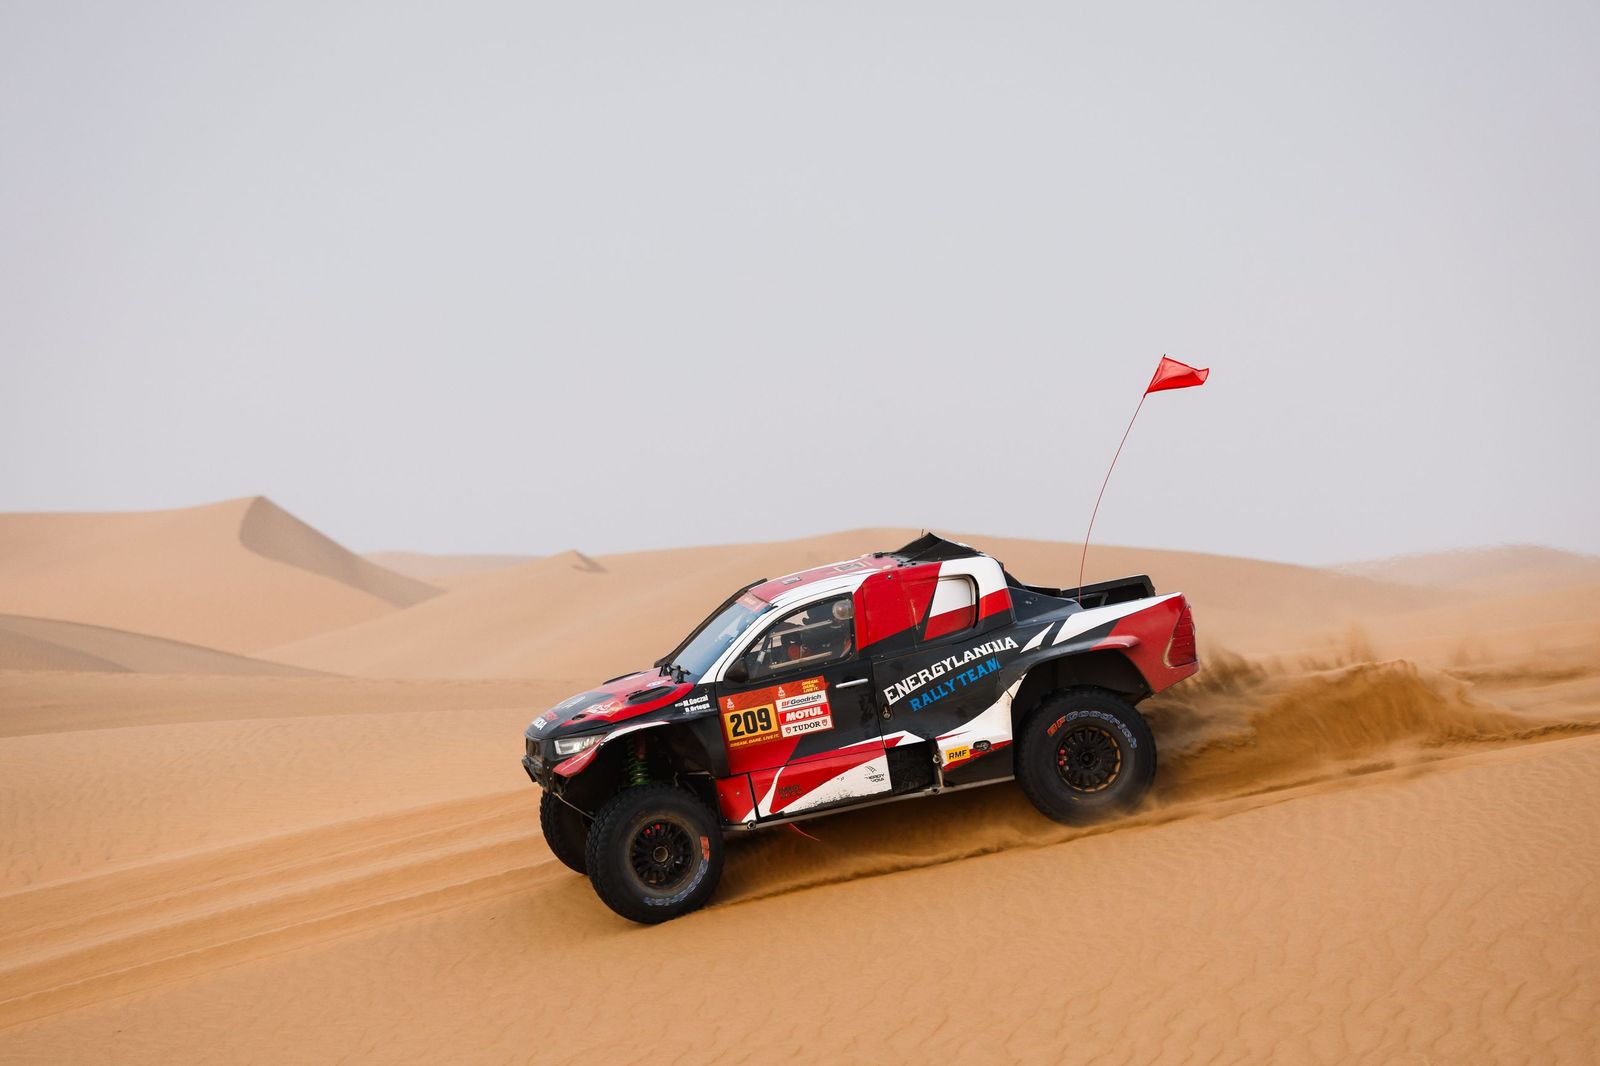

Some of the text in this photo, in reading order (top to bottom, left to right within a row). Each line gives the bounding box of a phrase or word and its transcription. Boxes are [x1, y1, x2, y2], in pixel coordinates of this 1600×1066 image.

[883, 636, 1019, 706] ENERGYLANDIA
[909, 656, 1003, 712] RALLY TEAM
[781, 694, 822, 707] BFGoodrich
[730, 707, 772, 737] 209
[785, 706, 823, 722] MOTUL
[792, 720, 821, 732] TUDOR
[948, 749, 968, 760] RMF
